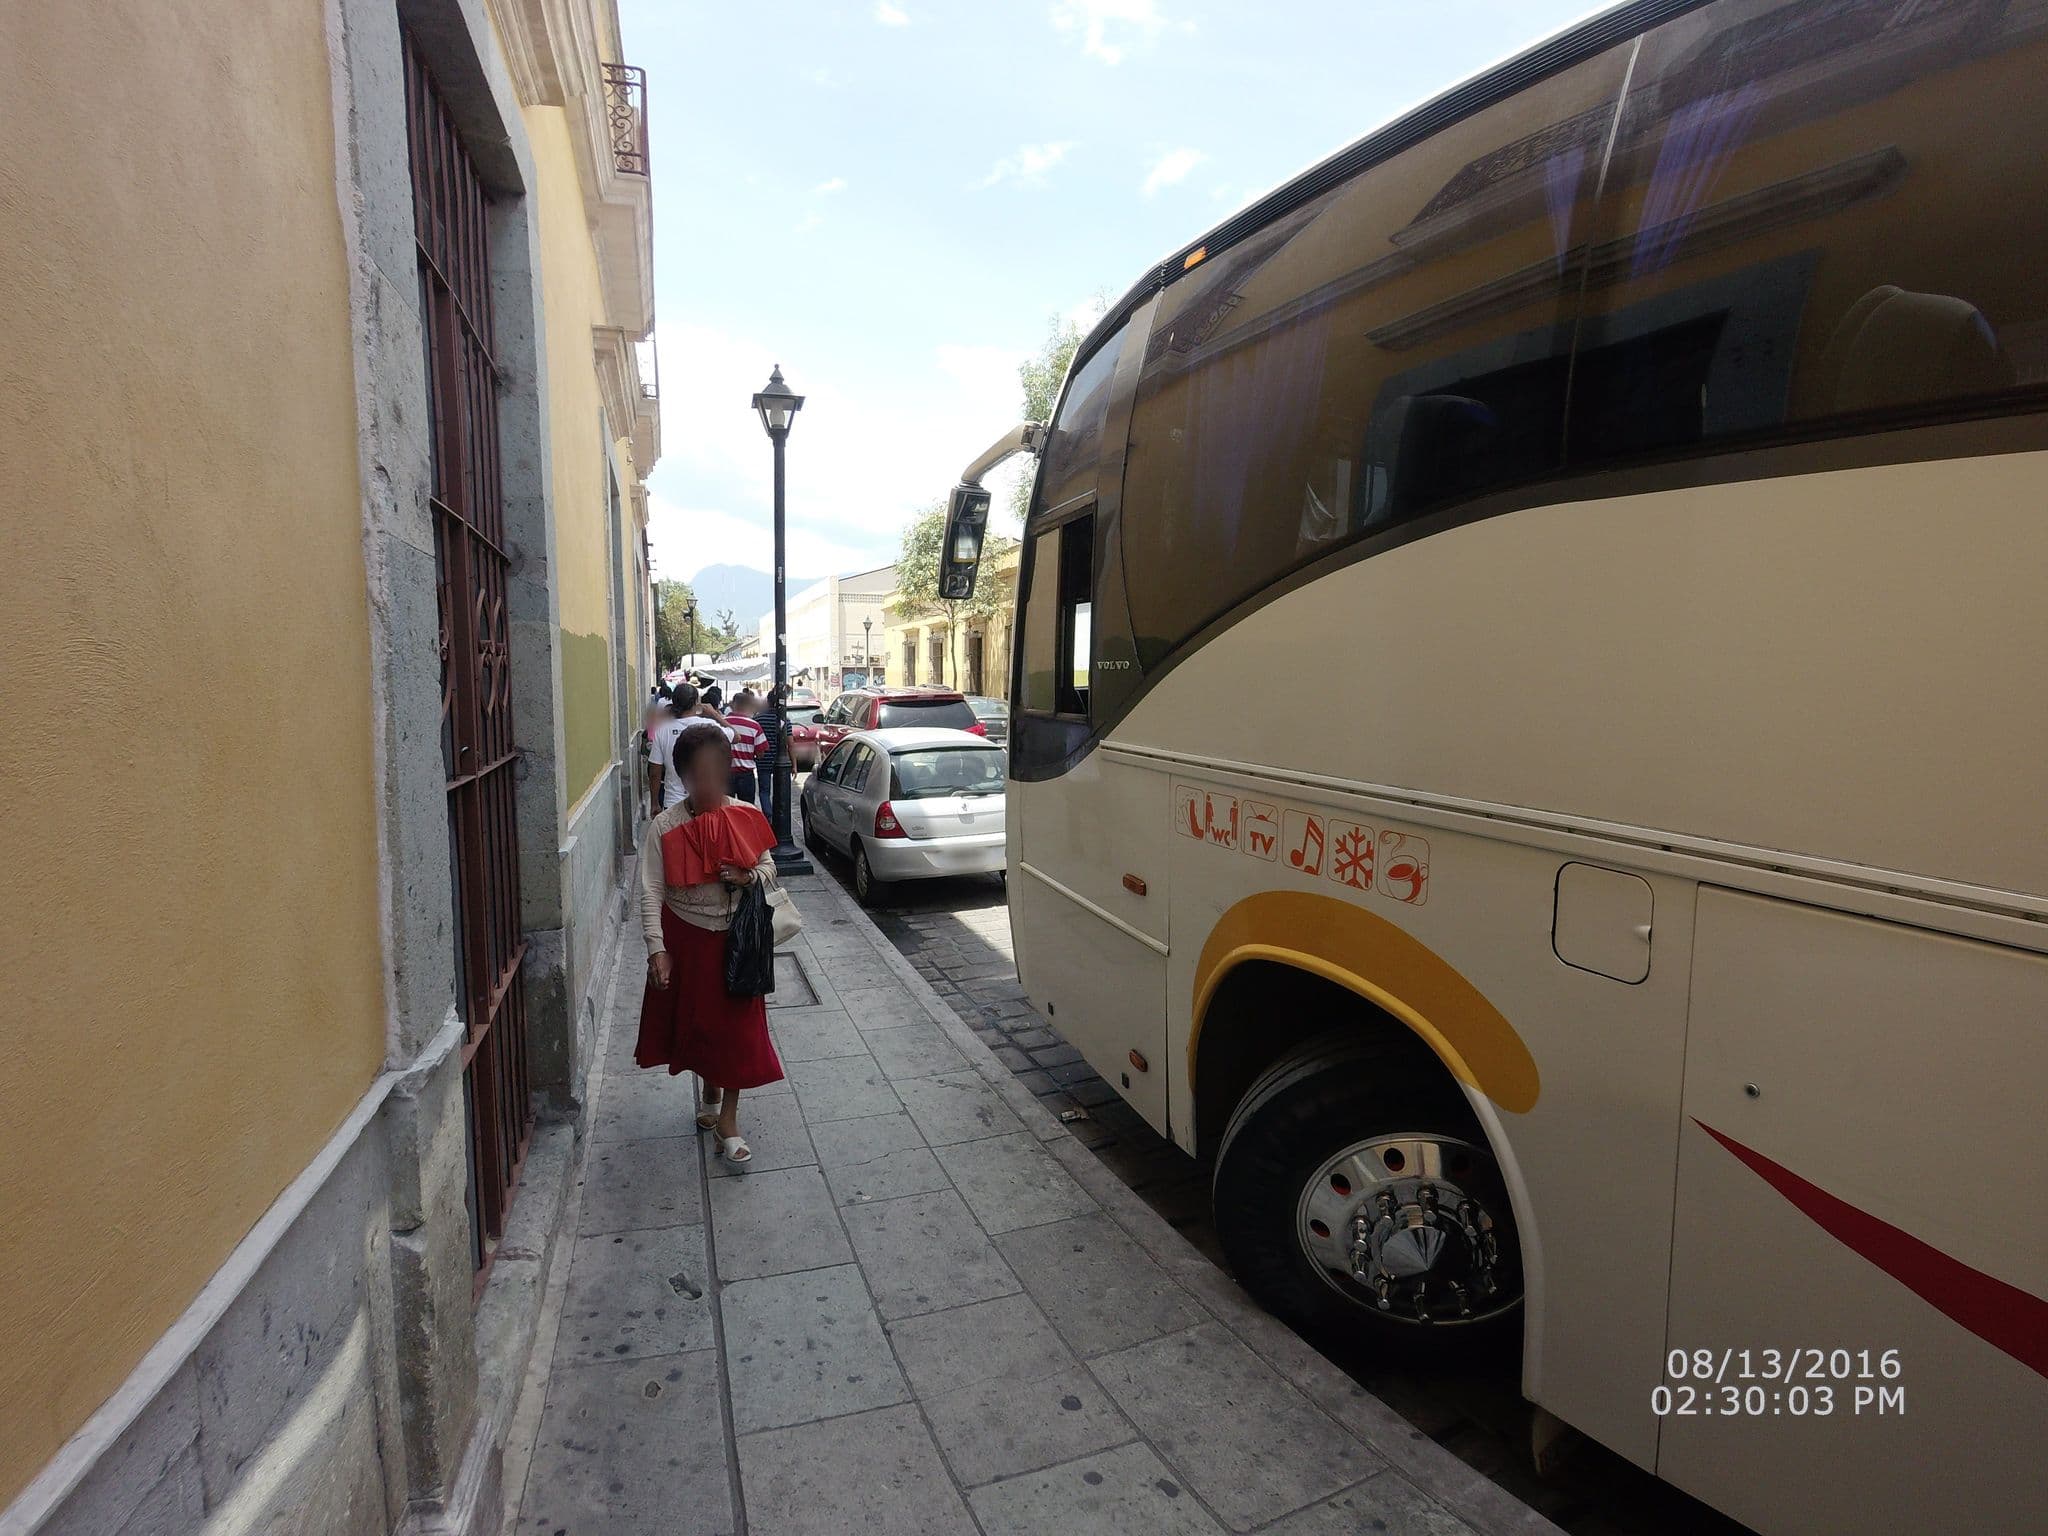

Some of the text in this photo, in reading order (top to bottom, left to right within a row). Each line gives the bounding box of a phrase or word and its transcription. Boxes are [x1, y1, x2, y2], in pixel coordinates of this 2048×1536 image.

[1097, 660, 1130, 670] VOLVO
[1211, 826, 1230, 846] WC
[1250, 831, 1275, 855] TV
